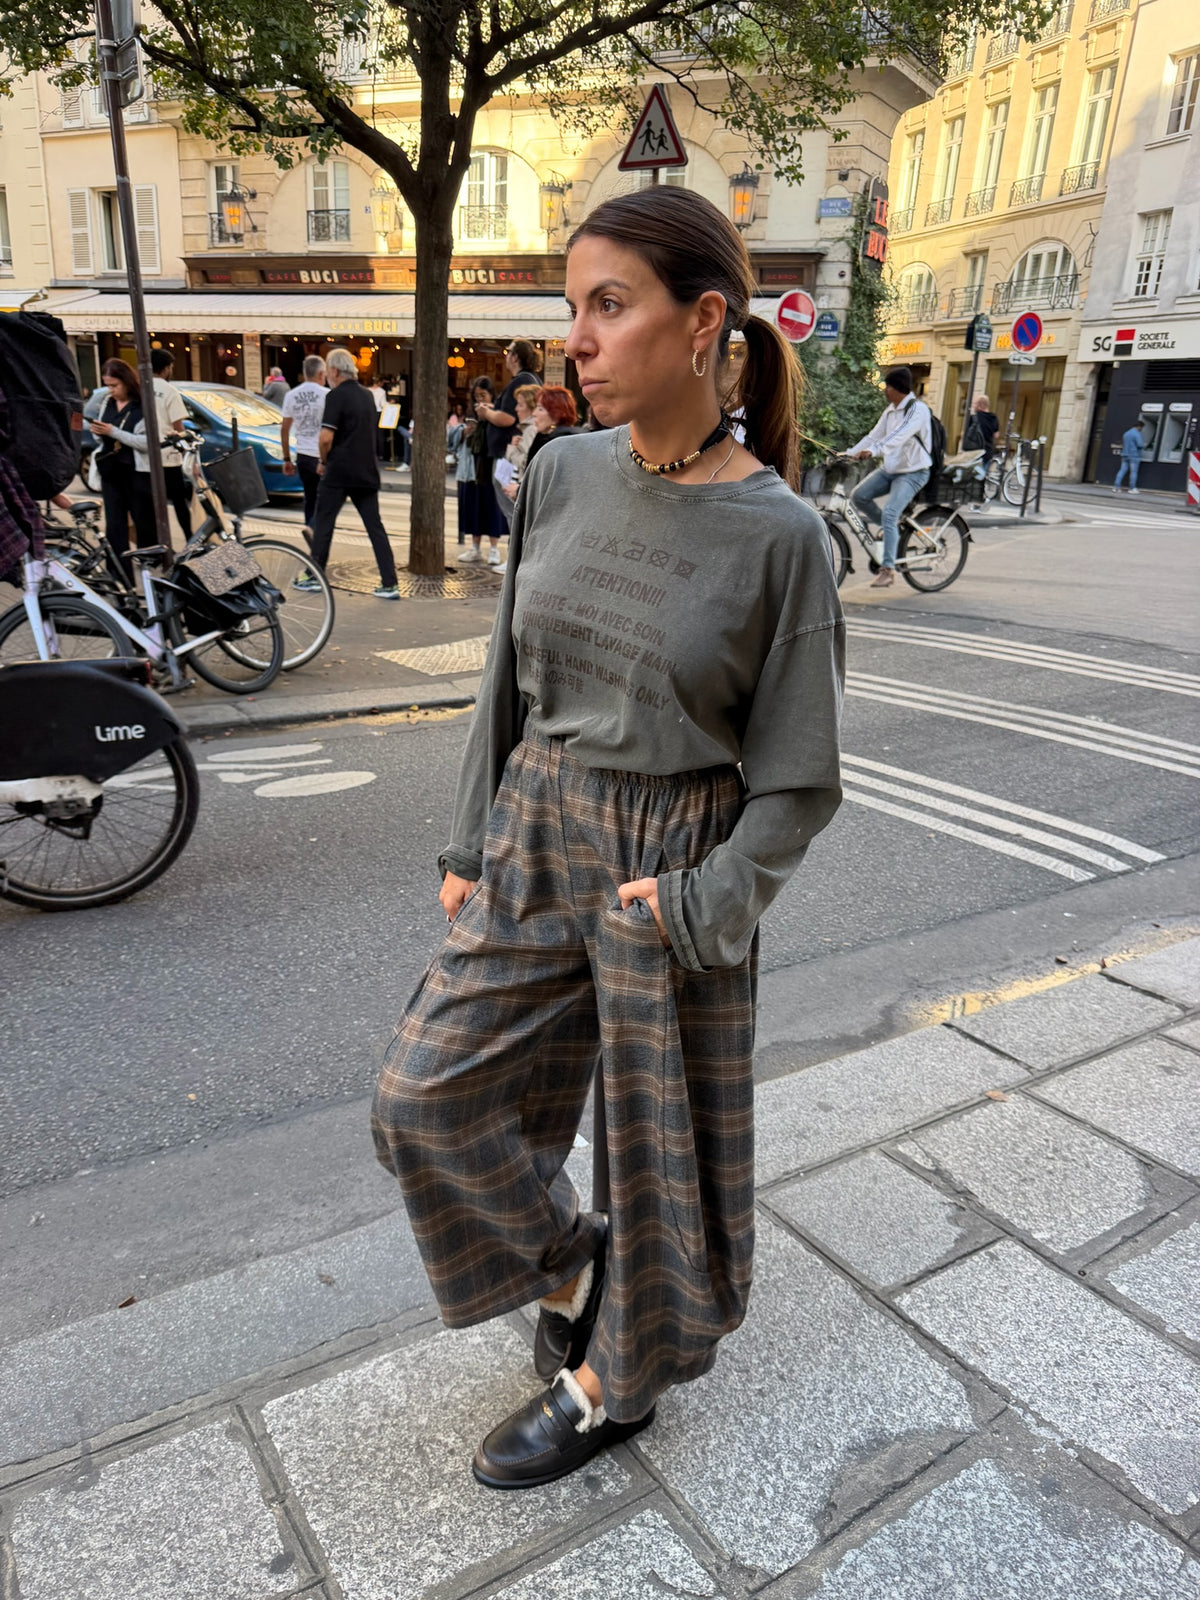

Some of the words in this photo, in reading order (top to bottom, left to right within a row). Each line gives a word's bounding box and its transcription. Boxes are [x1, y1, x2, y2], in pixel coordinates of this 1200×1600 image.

[874, 196, 888, 228] LE
[268, 272, 298, 281] CAFE
[299, 270, 339, 284] BUCI
[342, 272, 373, 281] CAFE
[452, 269, 496, 284] BUCI
[498, 272, 533, 281] CAFE
[363, 320, 397, 332] BUCI
[1092, 336, 1112, 352] SG
[1139, 332, 1169, 341] SOCIETE
[1137, 341, 1176, 350] GENERALE
[570, 564, 667, 608] ATTENTION!!!
[529, 590, 567, 611] TRAITE
[574, 602, 599, 621] MOI
[599, 610, 633, 633] AVEC
[633, 621, 667, 647] SOIN
[522, 610, 593, 643] UNIQUEMENT
[594, 631, 641, 661] LAVAGE
[641, 651, 677, 678] MAIN
[565, 654, 593, 675] HAND
[595, 663, 635, 698] WASHING
[635, 685, 671, 711] ONLY
[95, 724, 146, 742] Lime
